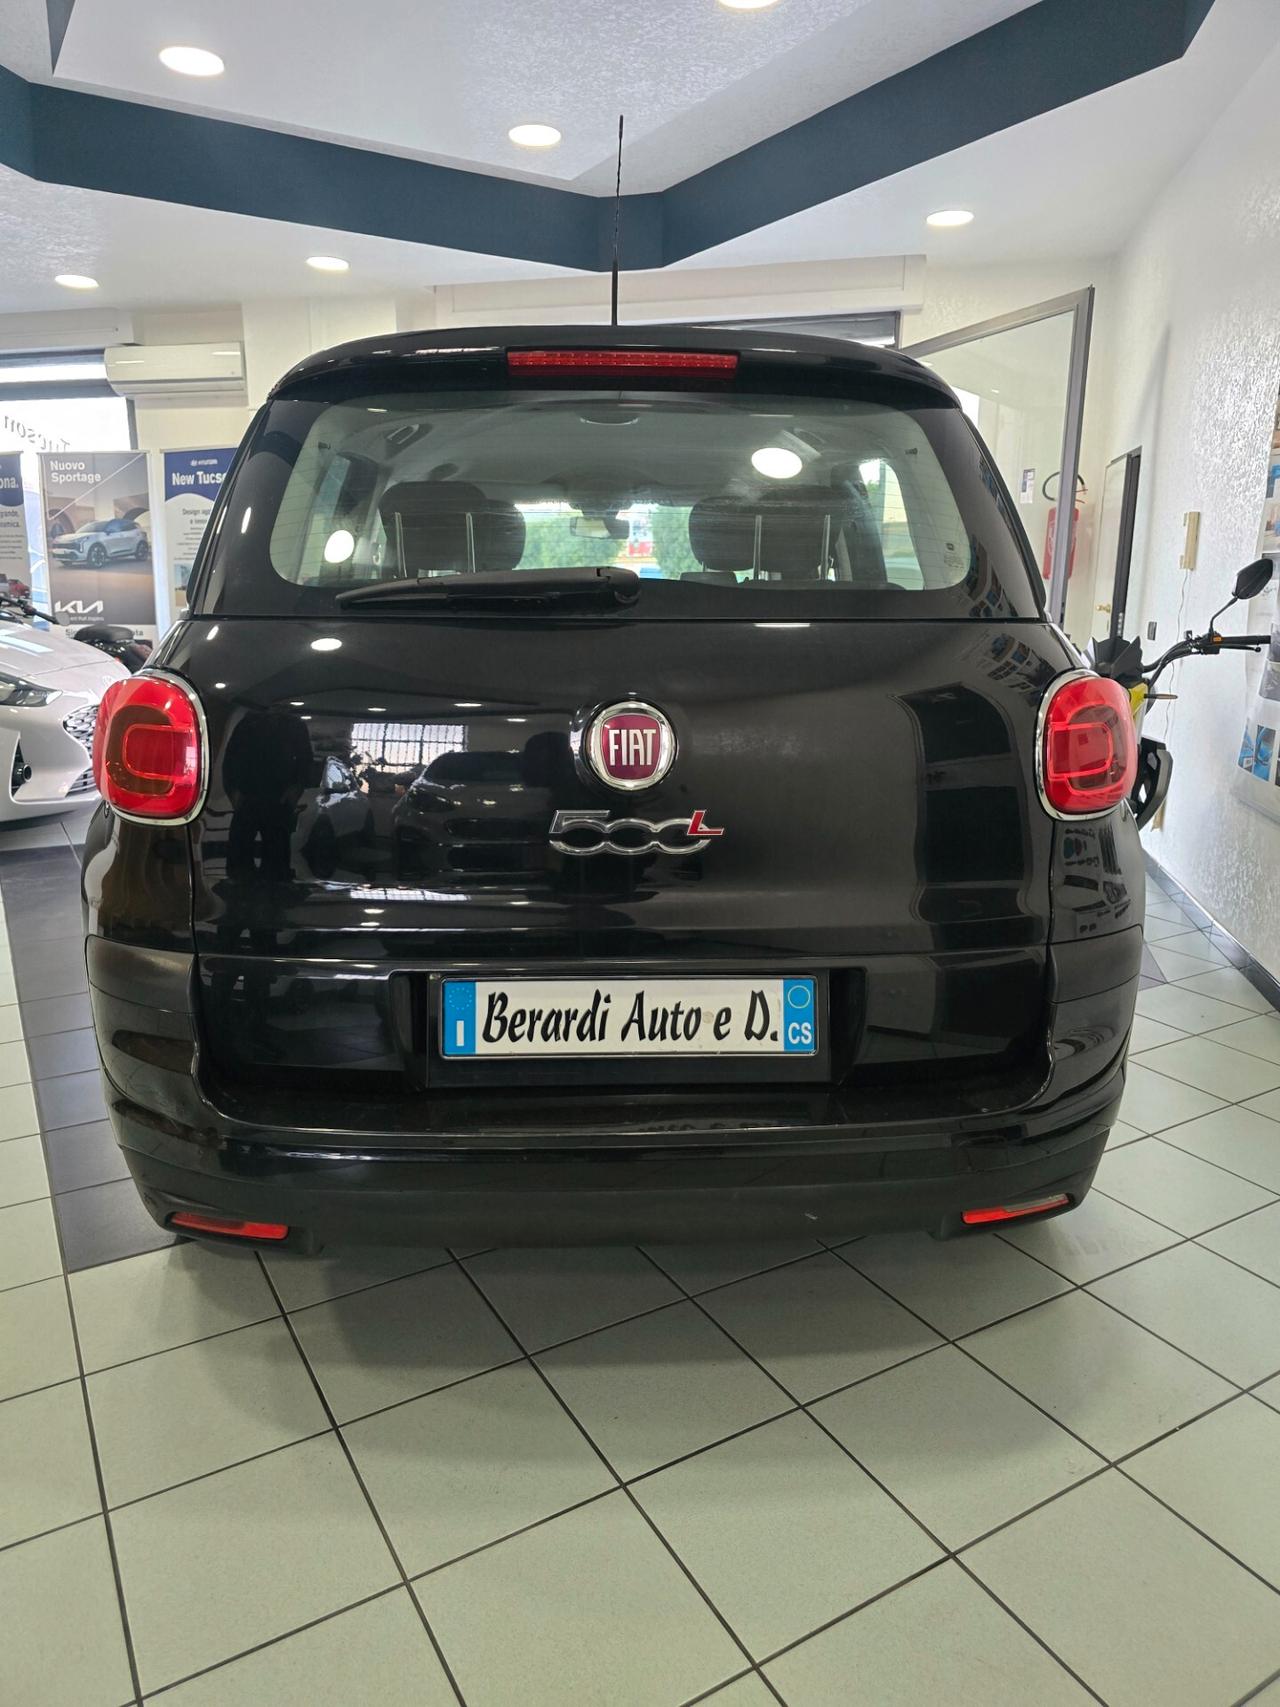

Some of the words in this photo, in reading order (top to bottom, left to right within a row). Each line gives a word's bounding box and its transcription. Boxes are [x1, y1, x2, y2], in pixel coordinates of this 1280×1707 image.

[50, 461, 85, 470] Nuovo
[51, 472, 101, 484] Sportage
[172, 473, 194, 485] New
[55, 600, 104, 614] KIA
[608, 729, 656, 766] FIAT
[549, 809, 725, 856] 500L
[482, 988, 612, 1043] Berardi
[621, 989, 702, 1042] Auto
[712, 1005, 732, 1041] e
[744, 989, 779, 1042] D.
[456, 1020, 465, 1047] I
[787, 1021, 812, 1045] CS
